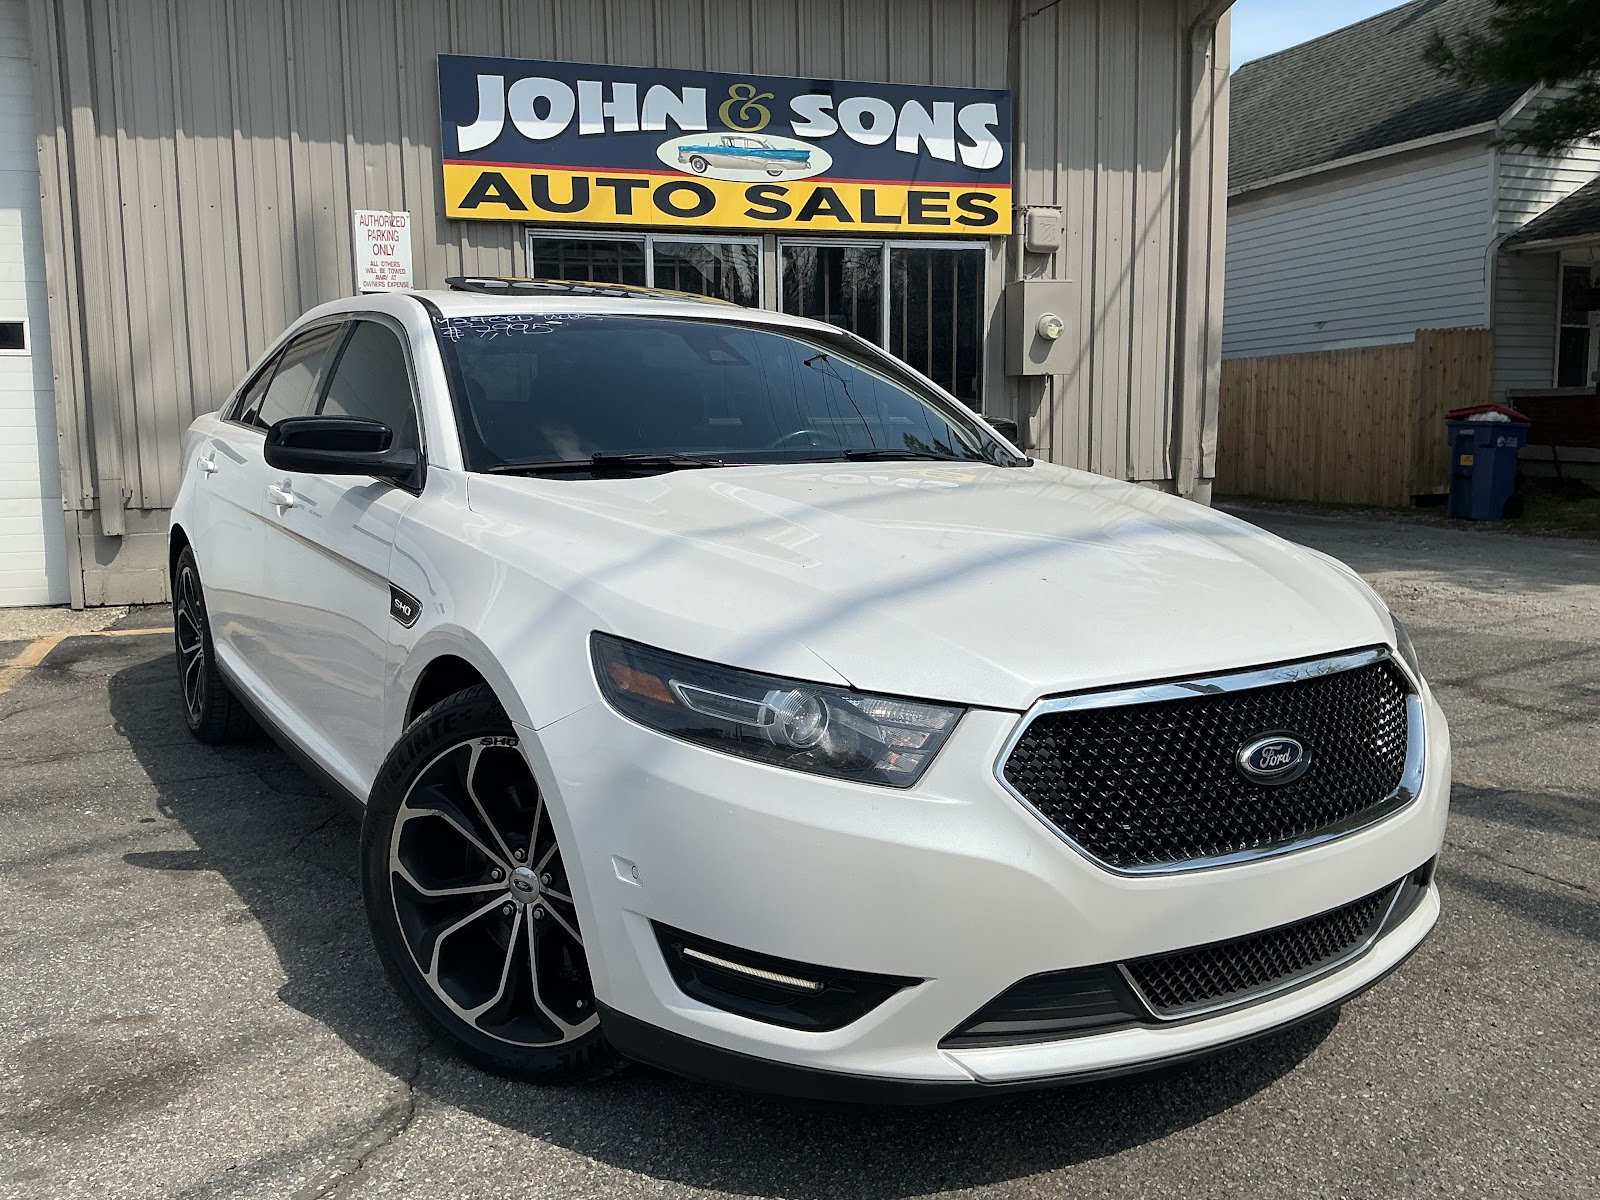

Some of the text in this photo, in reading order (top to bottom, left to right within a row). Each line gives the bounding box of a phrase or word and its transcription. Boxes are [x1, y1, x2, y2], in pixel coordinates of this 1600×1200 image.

[457, 74, 1004, 170] JOHN & SONS
[458, 171, 999, 227] AUTO SALES
[360, 214, 405, 227] AUTHORIZED
[367, 229, 400, 242] PARKING
[372, 243, 396, 256] ONLY
[394, 598, 412, 616] SHO
[480, 737, 520, 747] SHO
[1259, 744, 1292, 769] Ford
